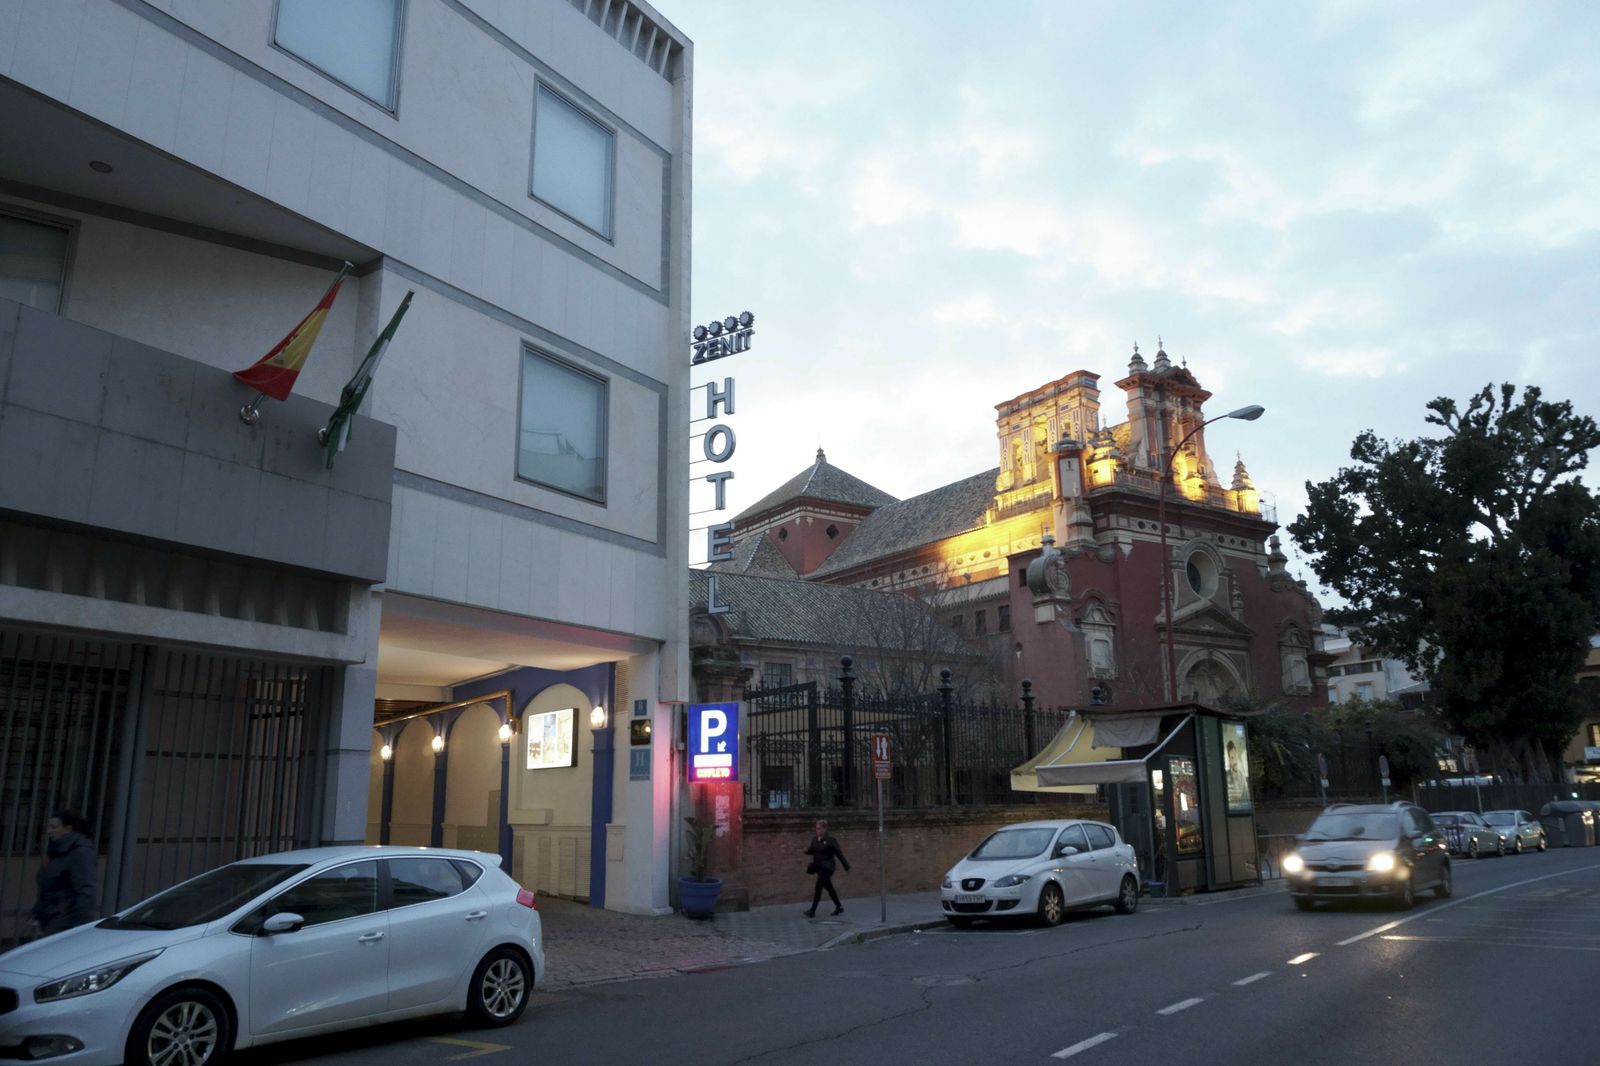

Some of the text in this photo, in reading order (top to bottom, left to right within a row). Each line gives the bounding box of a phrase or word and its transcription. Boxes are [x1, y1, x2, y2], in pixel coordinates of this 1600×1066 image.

[692, 329, 755, 364] ZENIT
[704, 377, 736, 614] HOTEL
[700, 709, 727, 753] P
